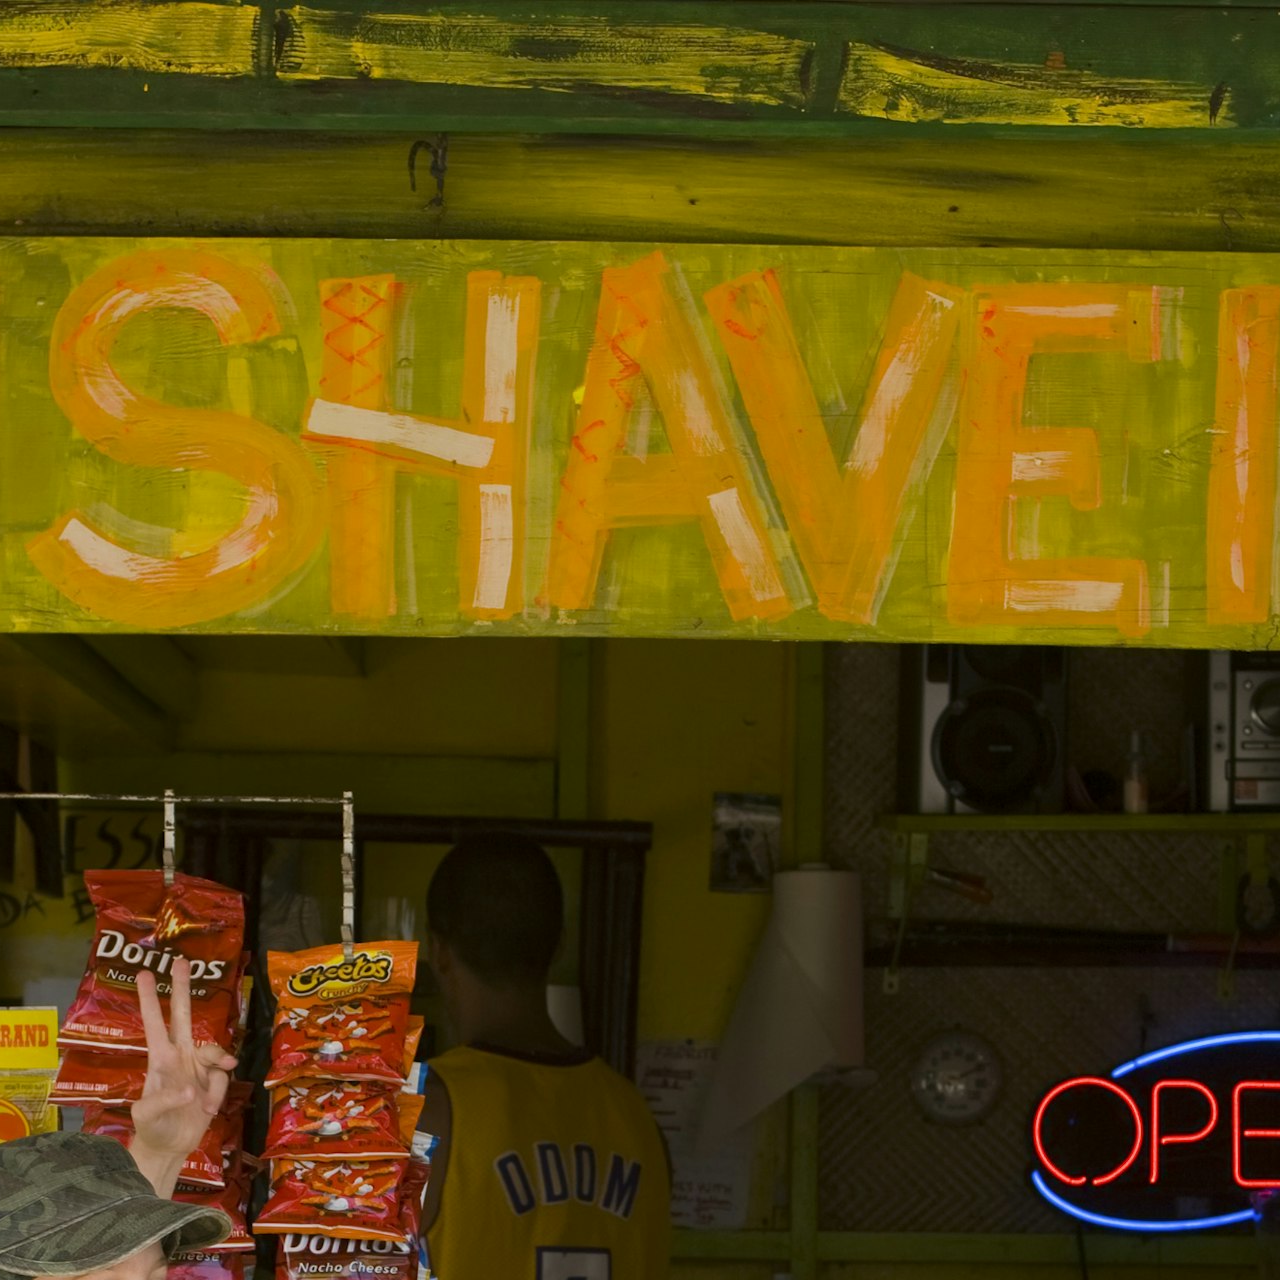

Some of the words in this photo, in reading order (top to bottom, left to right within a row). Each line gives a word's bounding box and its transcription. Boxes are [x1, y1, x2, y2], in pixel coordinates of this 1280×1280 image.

[27, 246, 1161, 637] SHAVE
[288, 951, 393, 997] Cheetos
[493, 1140, 642, 1222] ODOM
[297, 1261, 344, 1275] Nacho
[348, 1260, 399, 1276] Cheese
